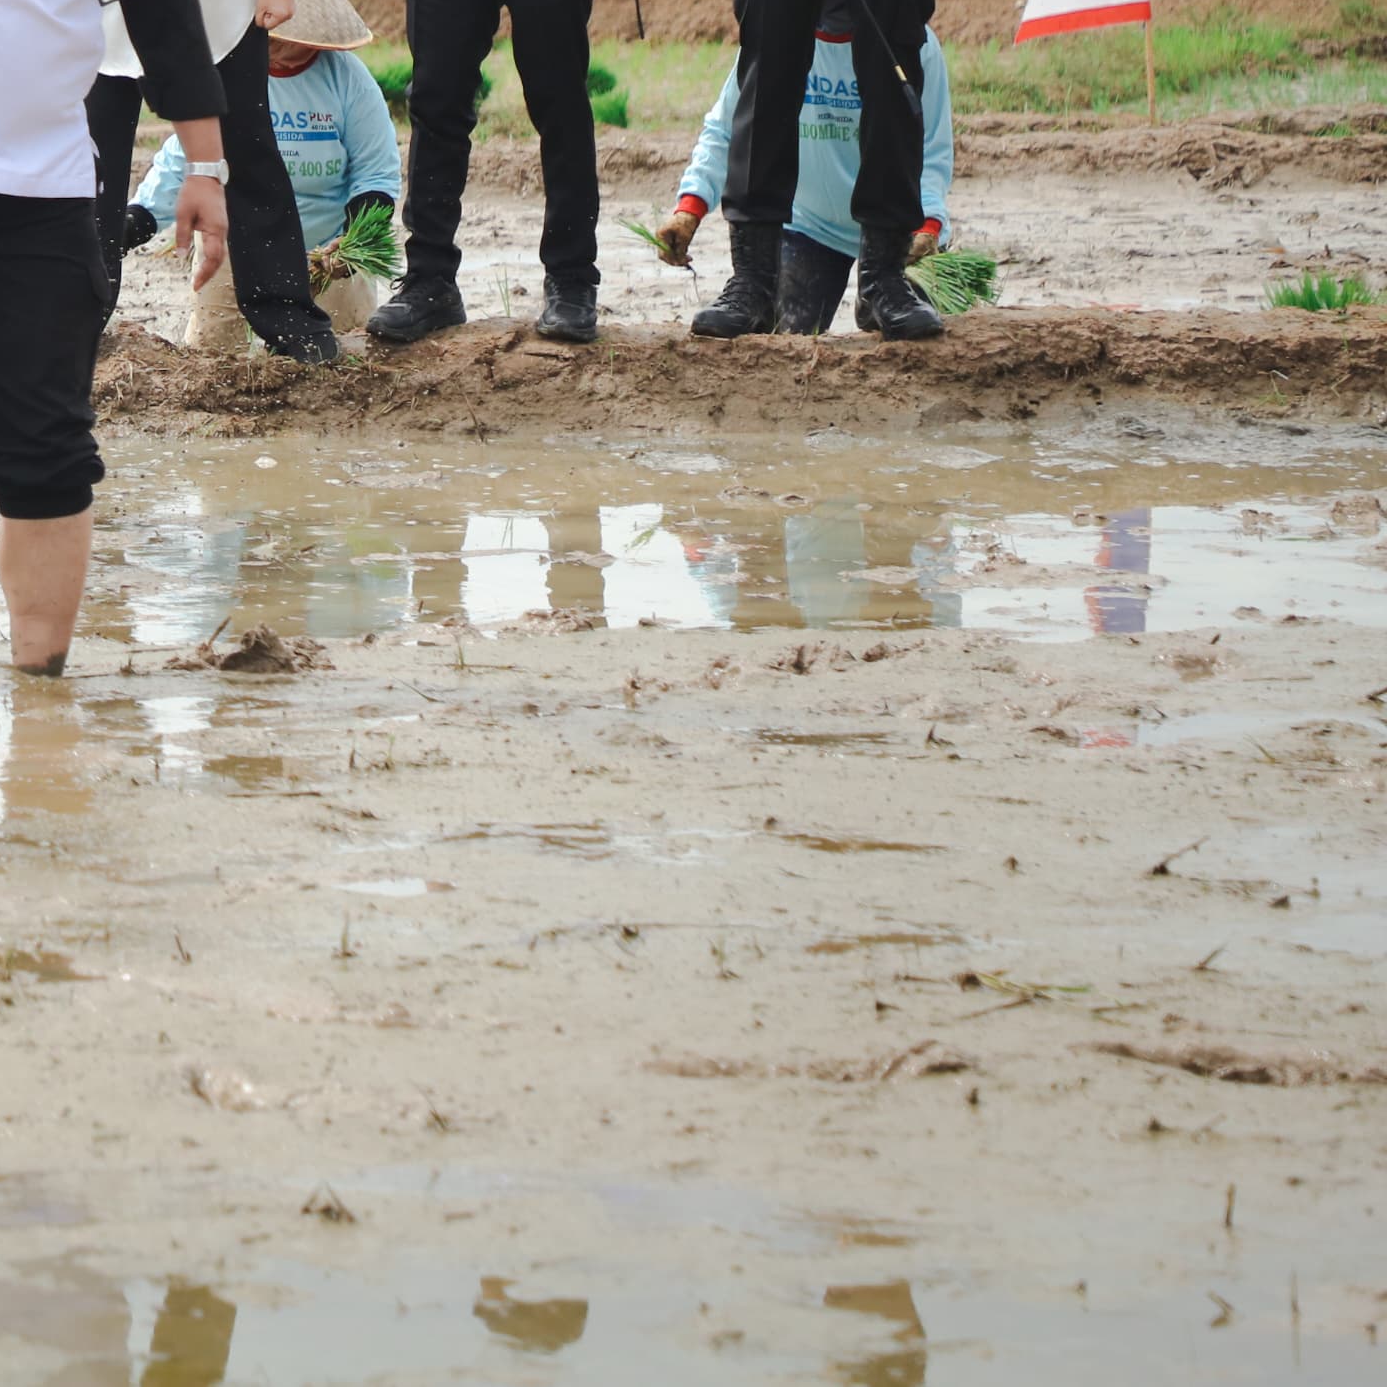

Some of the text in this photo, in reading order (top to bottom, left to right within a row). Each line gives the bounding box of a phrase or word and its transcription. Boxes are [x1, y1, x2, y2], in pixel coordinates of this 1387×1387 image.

[805, 75, 859, 96] NDAS
[270, 111, 308, 129] DAS
[299, 161, 323, 177] 400
[325, 158, 342, 176] SC
